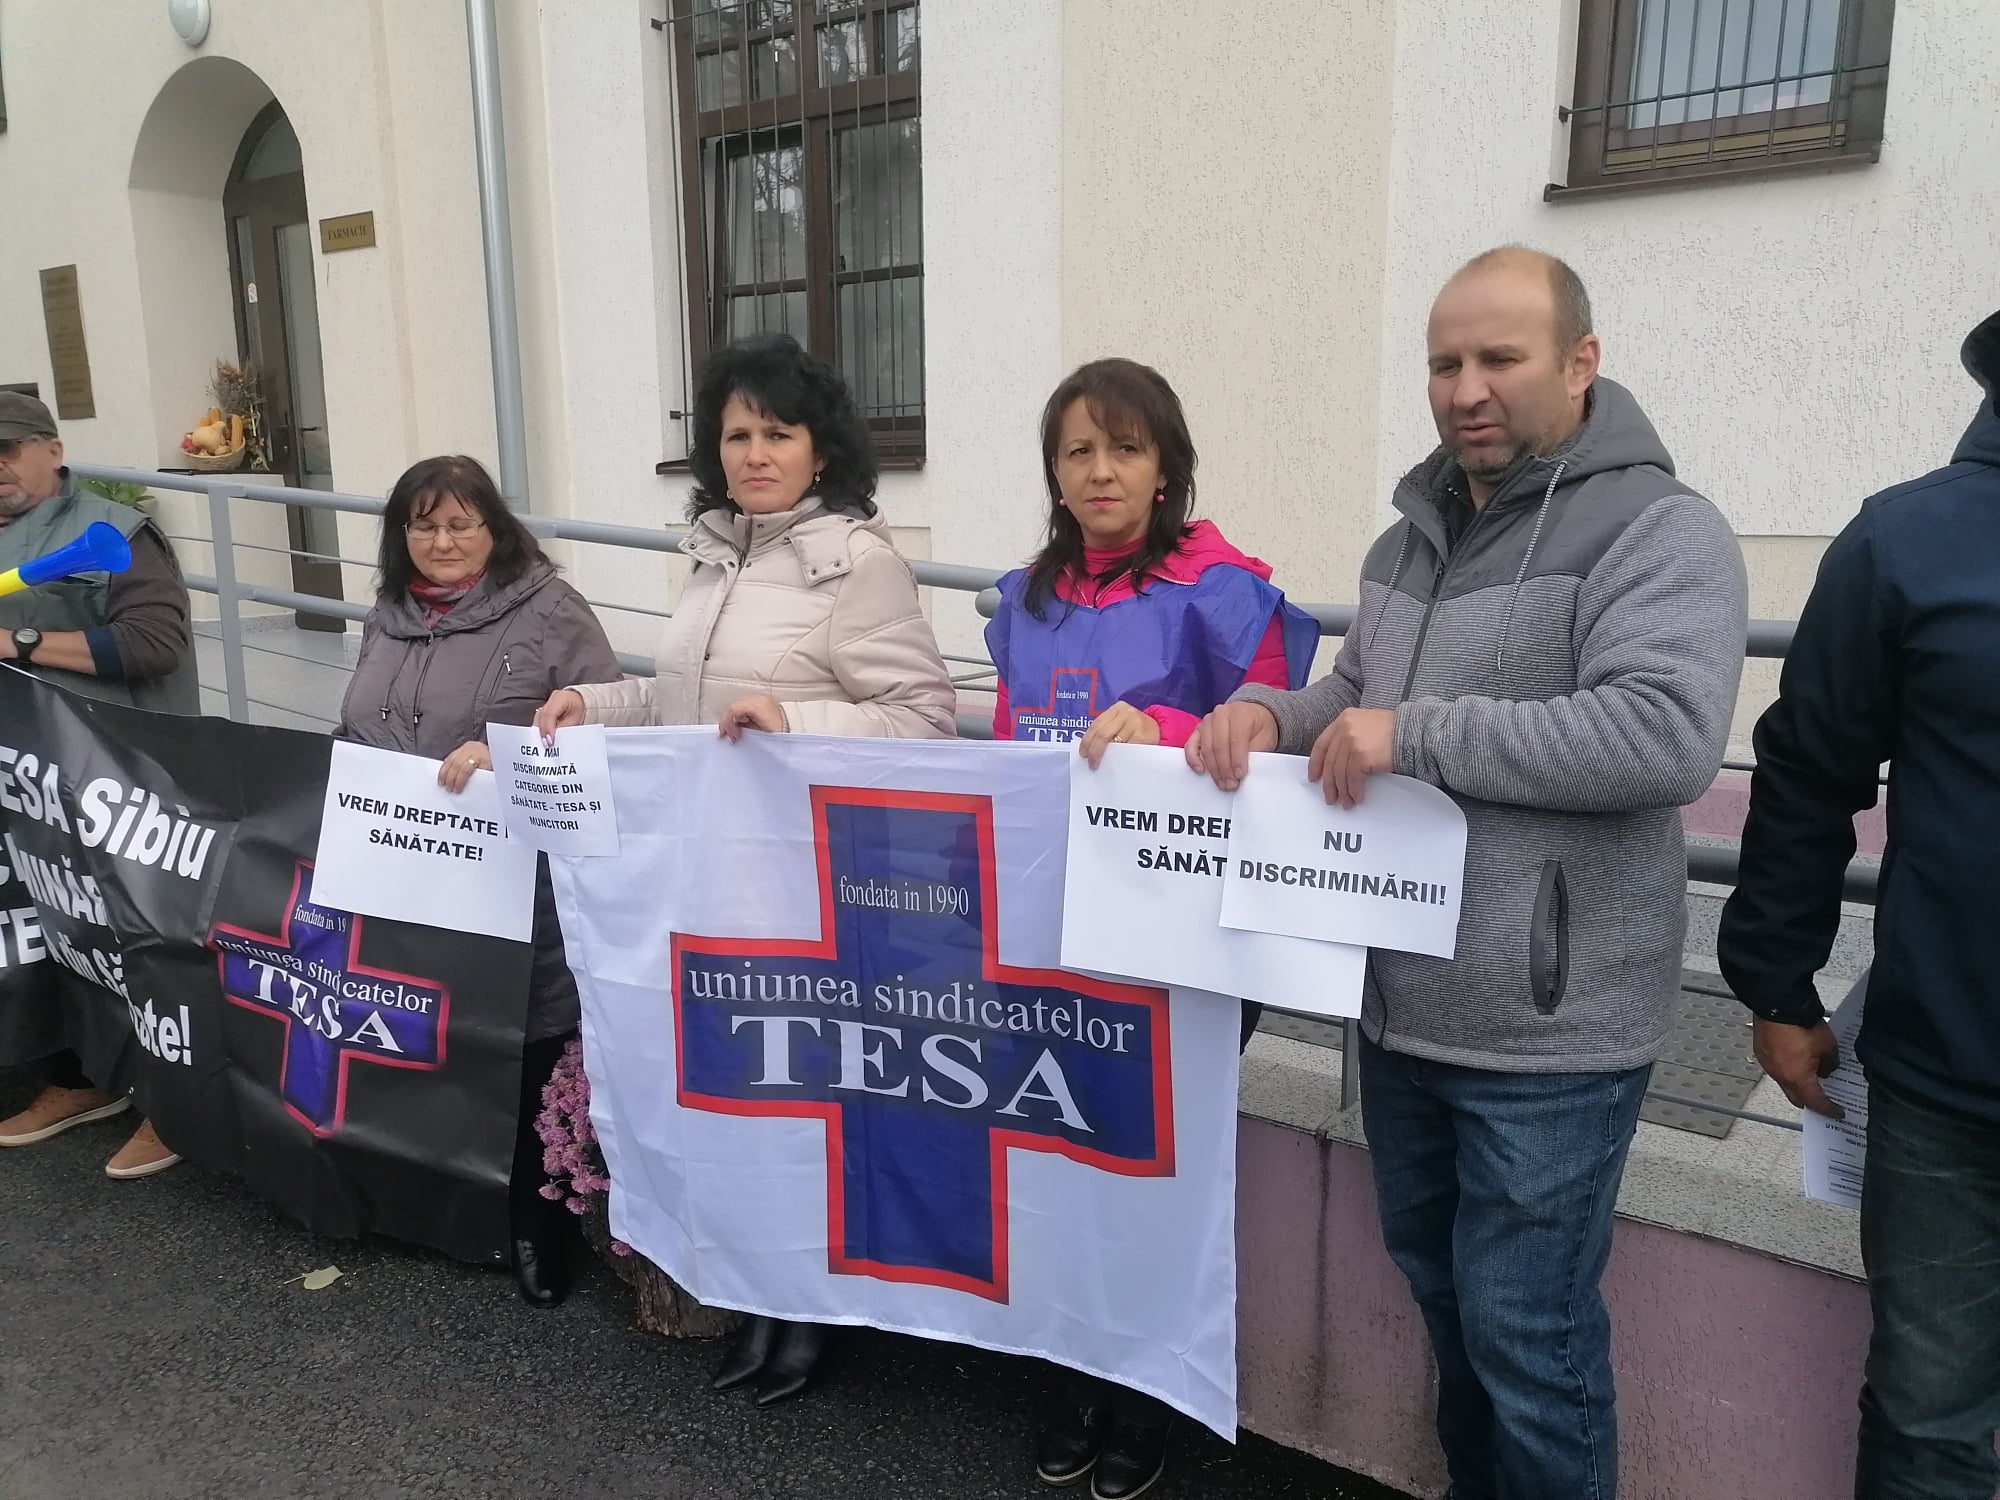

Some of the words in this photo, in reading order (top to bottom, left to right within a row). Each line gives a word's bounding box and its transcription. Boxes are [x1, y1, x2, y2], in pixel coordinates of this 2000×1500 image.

[1019, 713, 1058, 726] uniunea
[1062, 715, 1094, 728] sindic
[1028, 727, 1086, 743] TES
[520, 745, 539, 757] CEA
[544, 747, 560, 758] MAI
[512, 761, 577, 777] DISCRIMINATĂ
[514, 779, 559, 794] CATEGORIE
[561, 783, 583, 794] DIN
[0, 745, 71, 834] ESA
[76, 777, 217, 881] Sibiu
[338, 792, 389, 817] VREM
[393, 804, 499, 837] DREPTATE
[511, 794, 548, 812] SĂNĂTATE
[555, 801, 586, 813] TESA
[529, 816, 579, 831] MUNCITORI
[1086, 805, 1158, 833] VREM
[369, 827, 483, 862] SĂNĂTATE!
[1323, 830, 1363, 854] NU
[1137, 845, 1228, 878] SĂNĂT
[839, 875, 899, 910] fondata
[904, 881, 921, 912] in
[927, 884, 970, 916] 1990
[1239, 859, 1447, 906] DISCRIMINĂRII!
[294, 903, 325, 930] fondata
[326, 913, 335, 930] in
[215, 939, 303, 973] uniunea
[248, 958, 404, 1054] TESA
[688, 960, 862, 1009] uniunea
[874, 974, 1135, 1054] sindicatelor
[731, 1014, 1095, 1134] TESA
